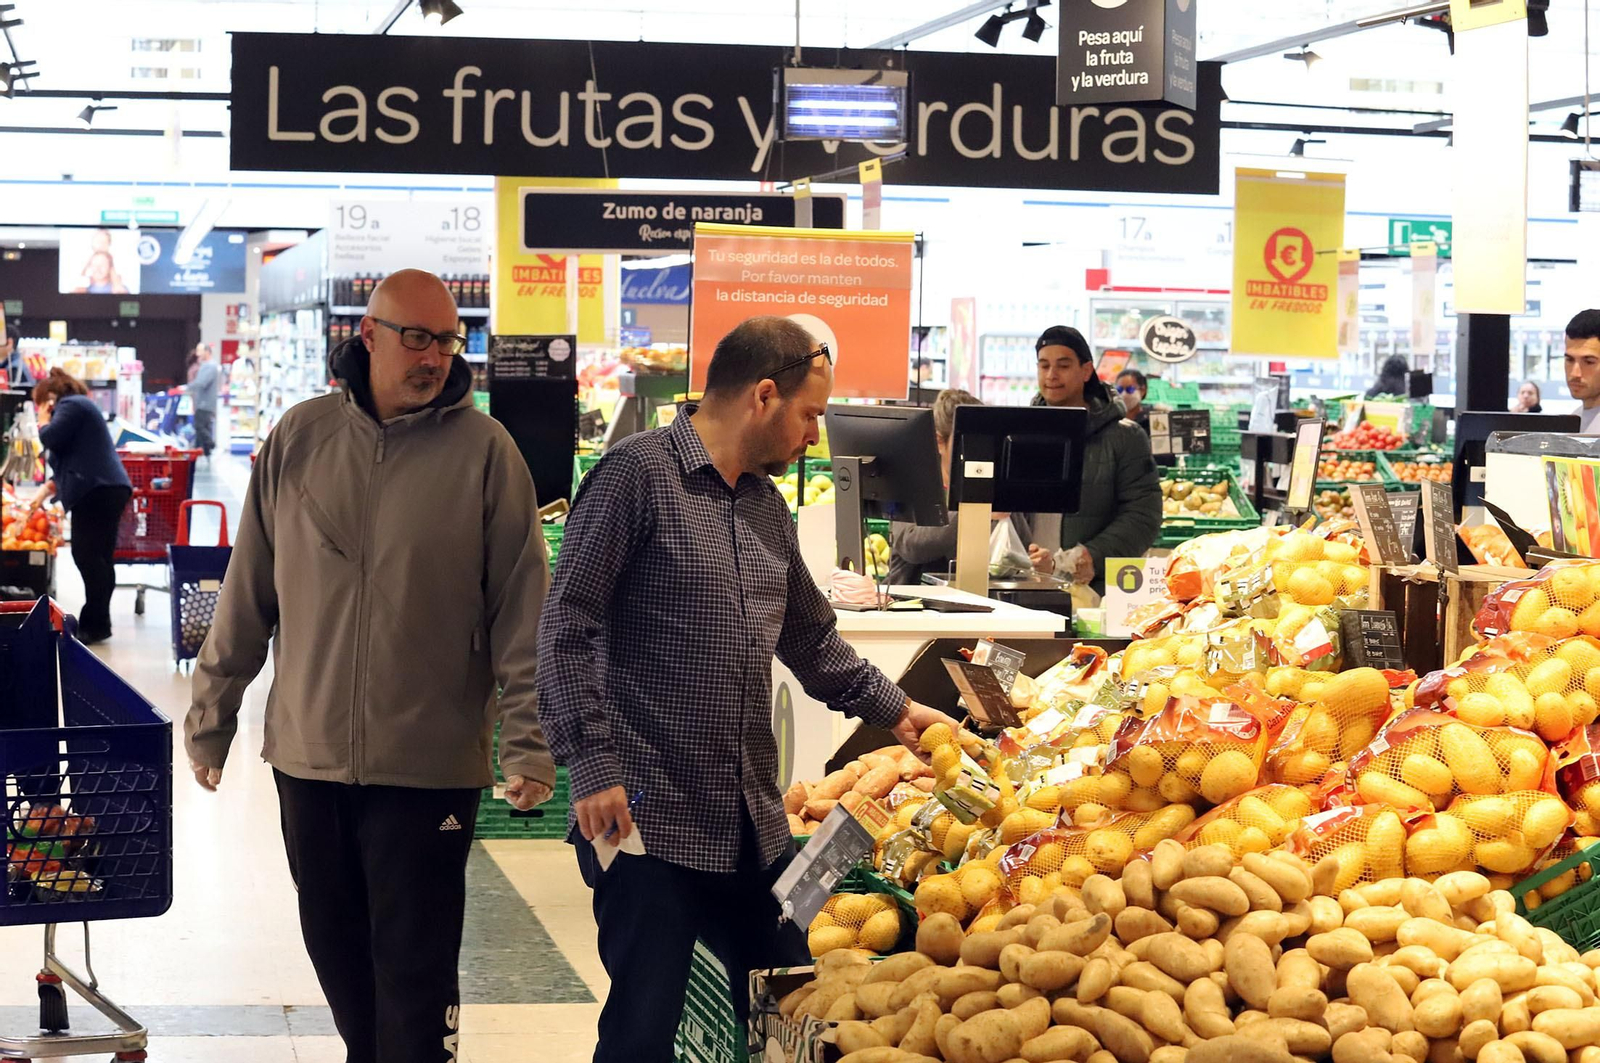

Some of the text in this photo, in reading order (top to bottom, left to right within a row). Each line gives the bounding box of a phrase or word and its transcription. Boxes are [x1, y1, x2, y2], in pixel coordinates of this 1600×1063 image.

[1079, 25, 1144, 47] Pesa aquí
[1086, 49, 1134, 66] la fruta
[1071, 69, 1149, 92] y la verdura
[268, 65, 1196, 173] Las frutas y rduras
[602, 202, 763, 224] Zumo de naranja
[708, 250, 899, 268] Tu seguridad es la de todos.
[741, 270, 862, 286] Por favor manten
[517, 284, 538, 296] EN
[716, 288, 888, 308] la distancia de seguridad
[1247, 281, 1327, 300] IMBATIBLES
[1249, 299, 1322, 314] EN FRESCOS
[1149, 567, 1160, 575] Tu
[439, 823, 462, 831] adidas
